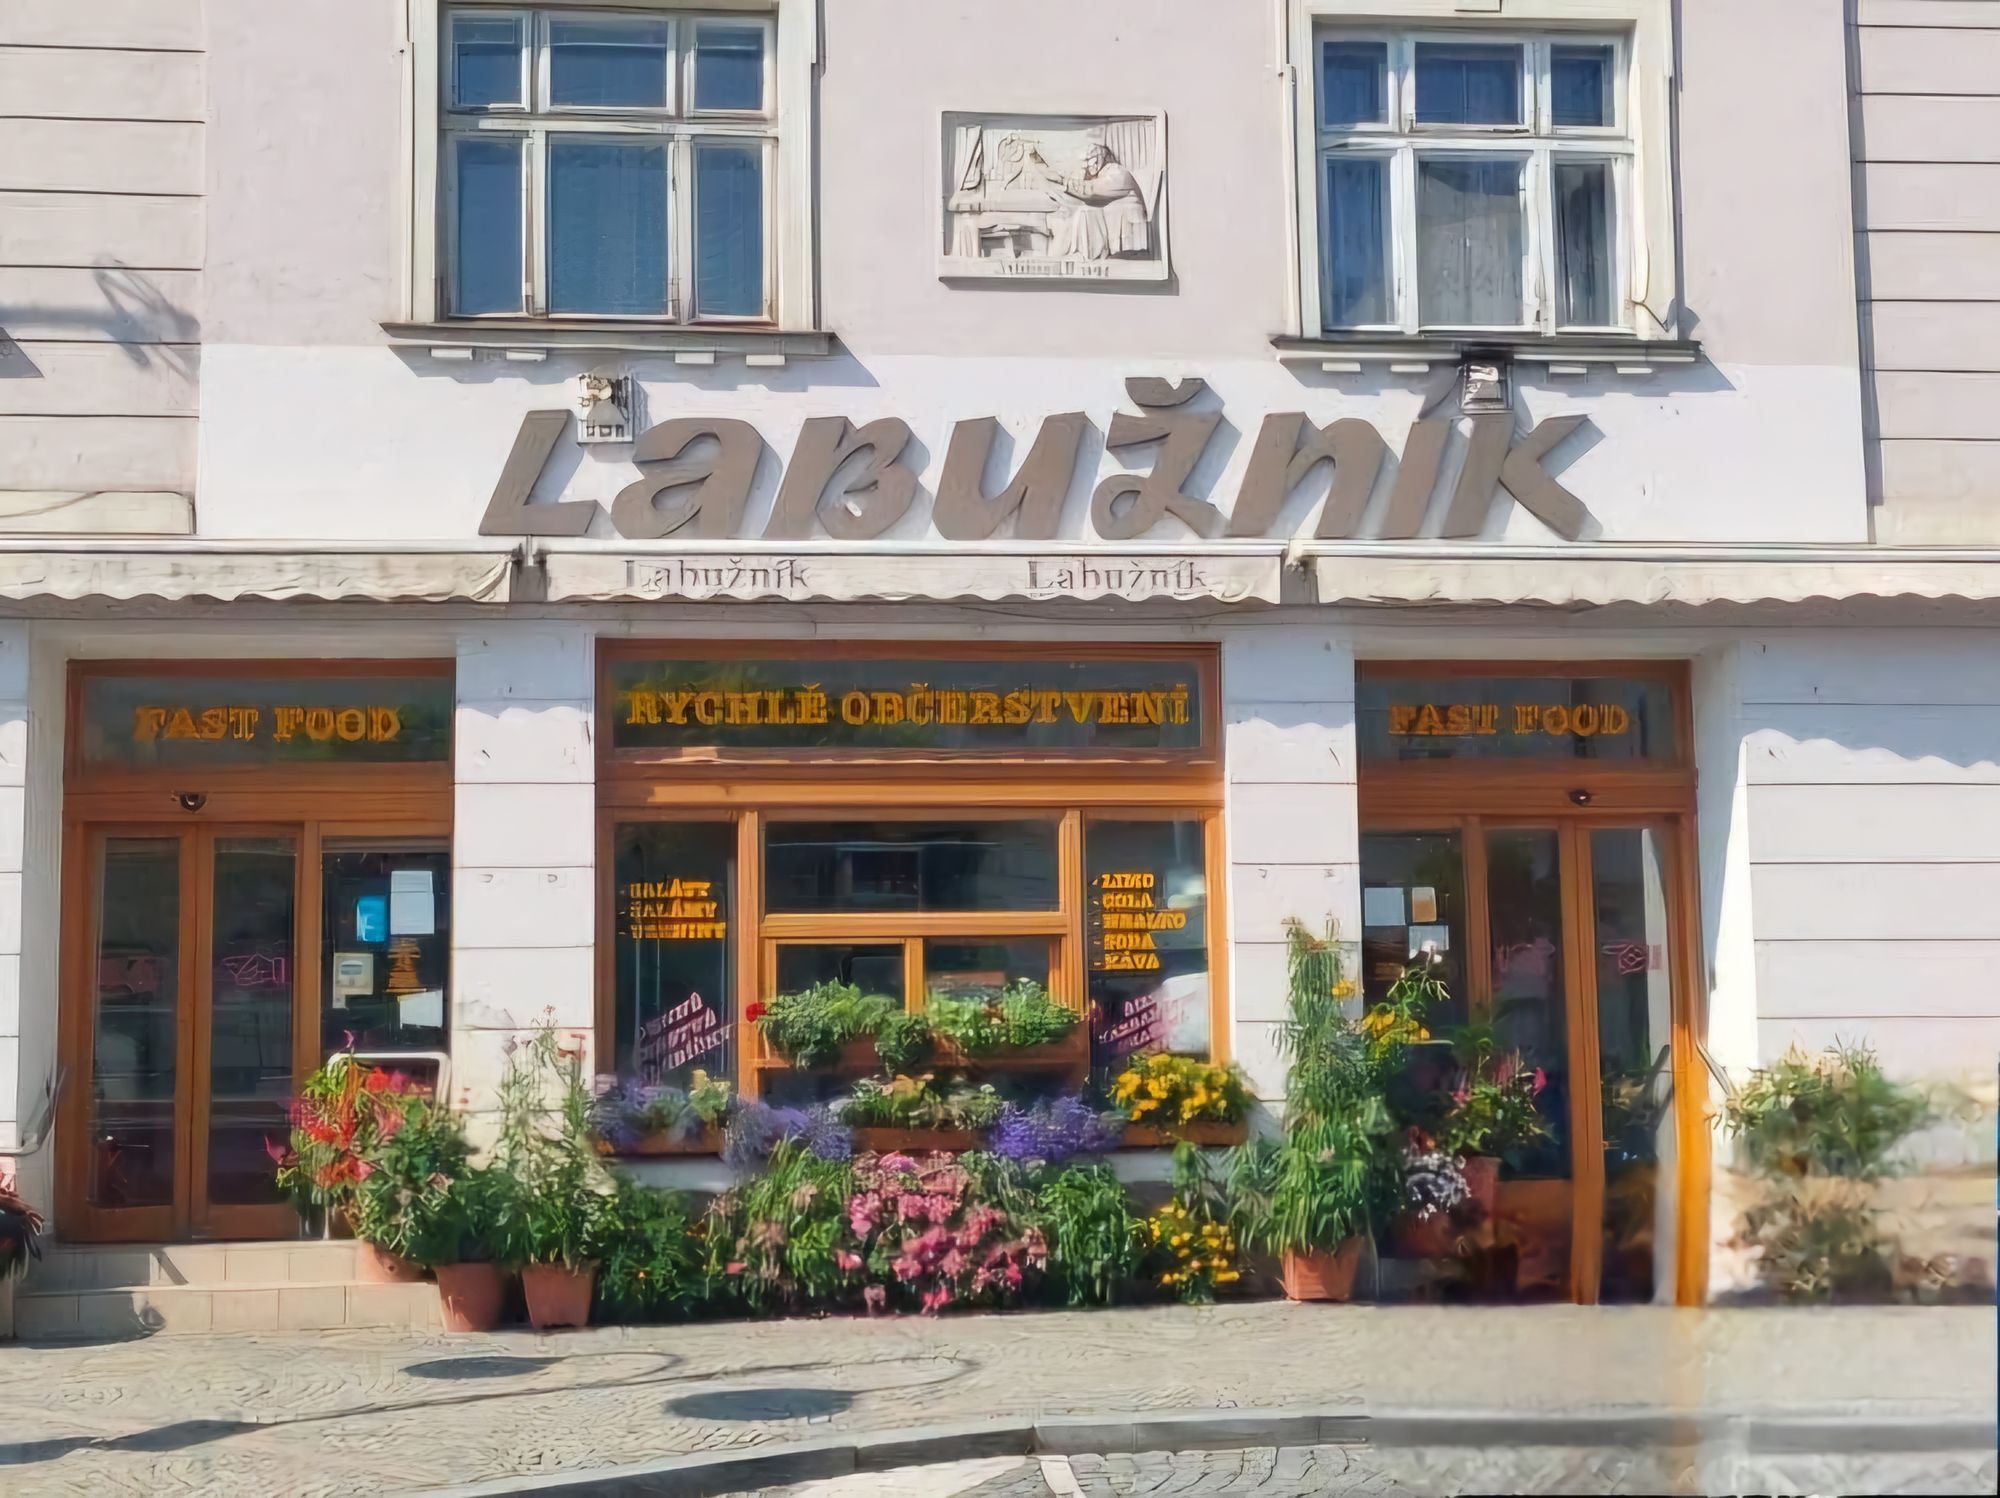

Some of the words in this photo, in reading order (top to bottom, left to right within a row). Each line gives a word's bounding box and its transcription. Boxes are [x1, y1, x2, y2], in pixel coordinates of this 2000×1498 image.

[133, 705, 259, 742] FAST
[272, 705, 402, 742] FOOD
[1389, 703, 1498, 736] FAST
[1513, 703, 1629, 737] FOOD
